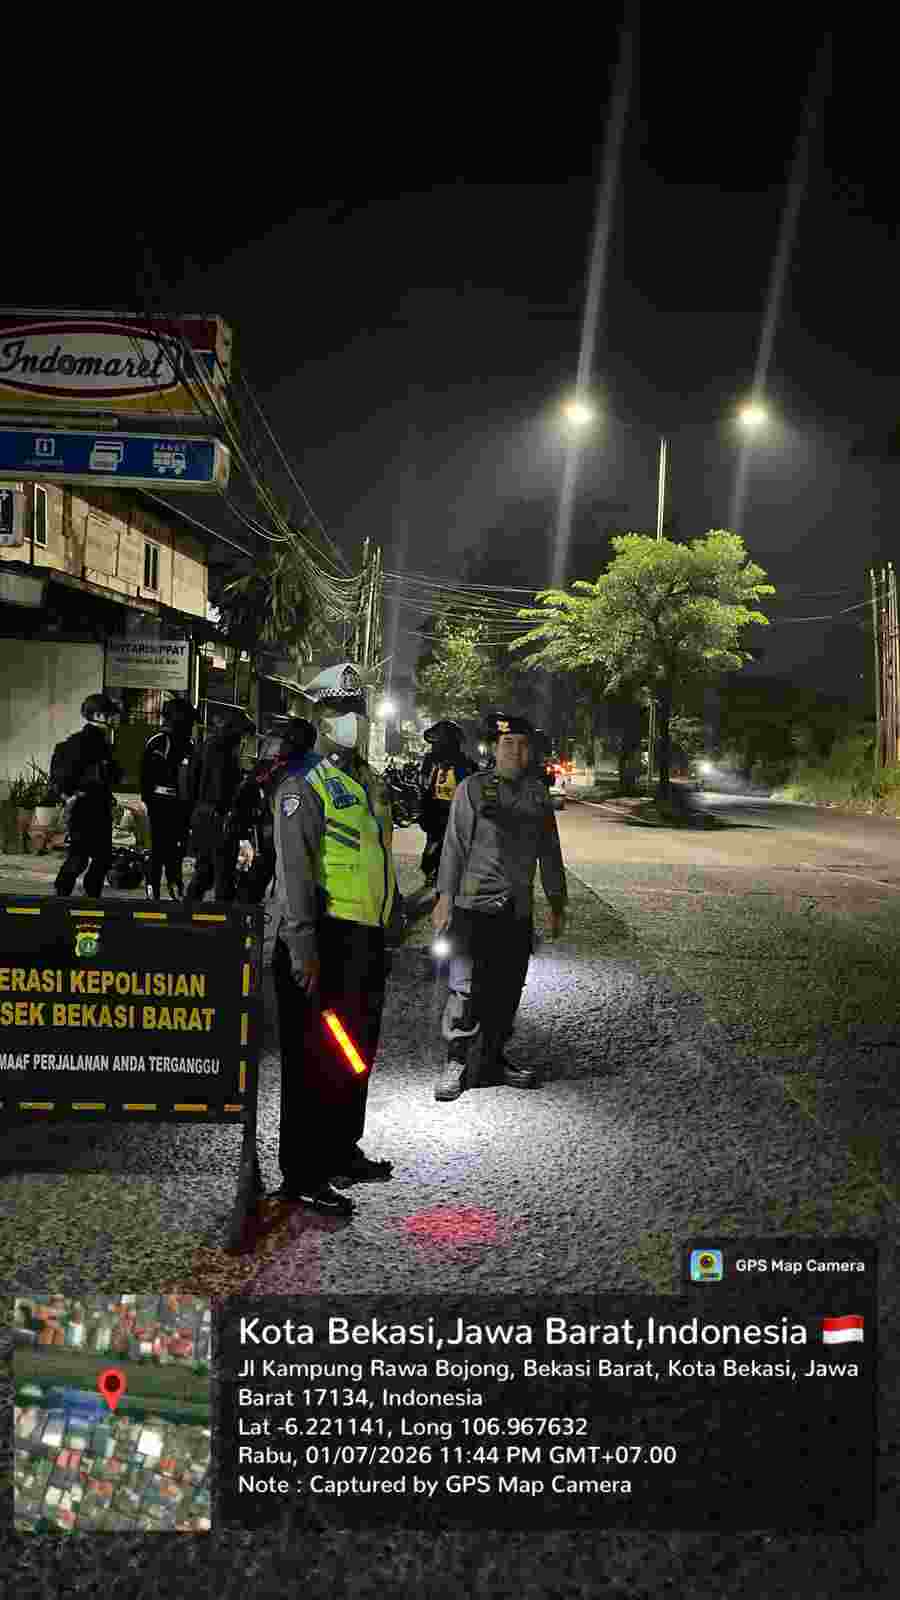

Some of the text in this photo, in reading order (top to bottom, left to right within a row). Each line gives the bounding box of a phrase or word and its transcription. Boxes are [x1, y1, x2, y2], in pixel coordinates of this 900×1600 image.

[0, 342, 164, 378] Indomaret
[0, 967, 207, 997] ERASI KEPOLISIAN
[0, 1000, 216, 1032] SEK BEKASI BARAT
[33, 1054, 109, 1071] PERJALANAN
[112, 1056, 146, 1072] ANDA
[149, 1056, 221, 1074] TERGANGGU
